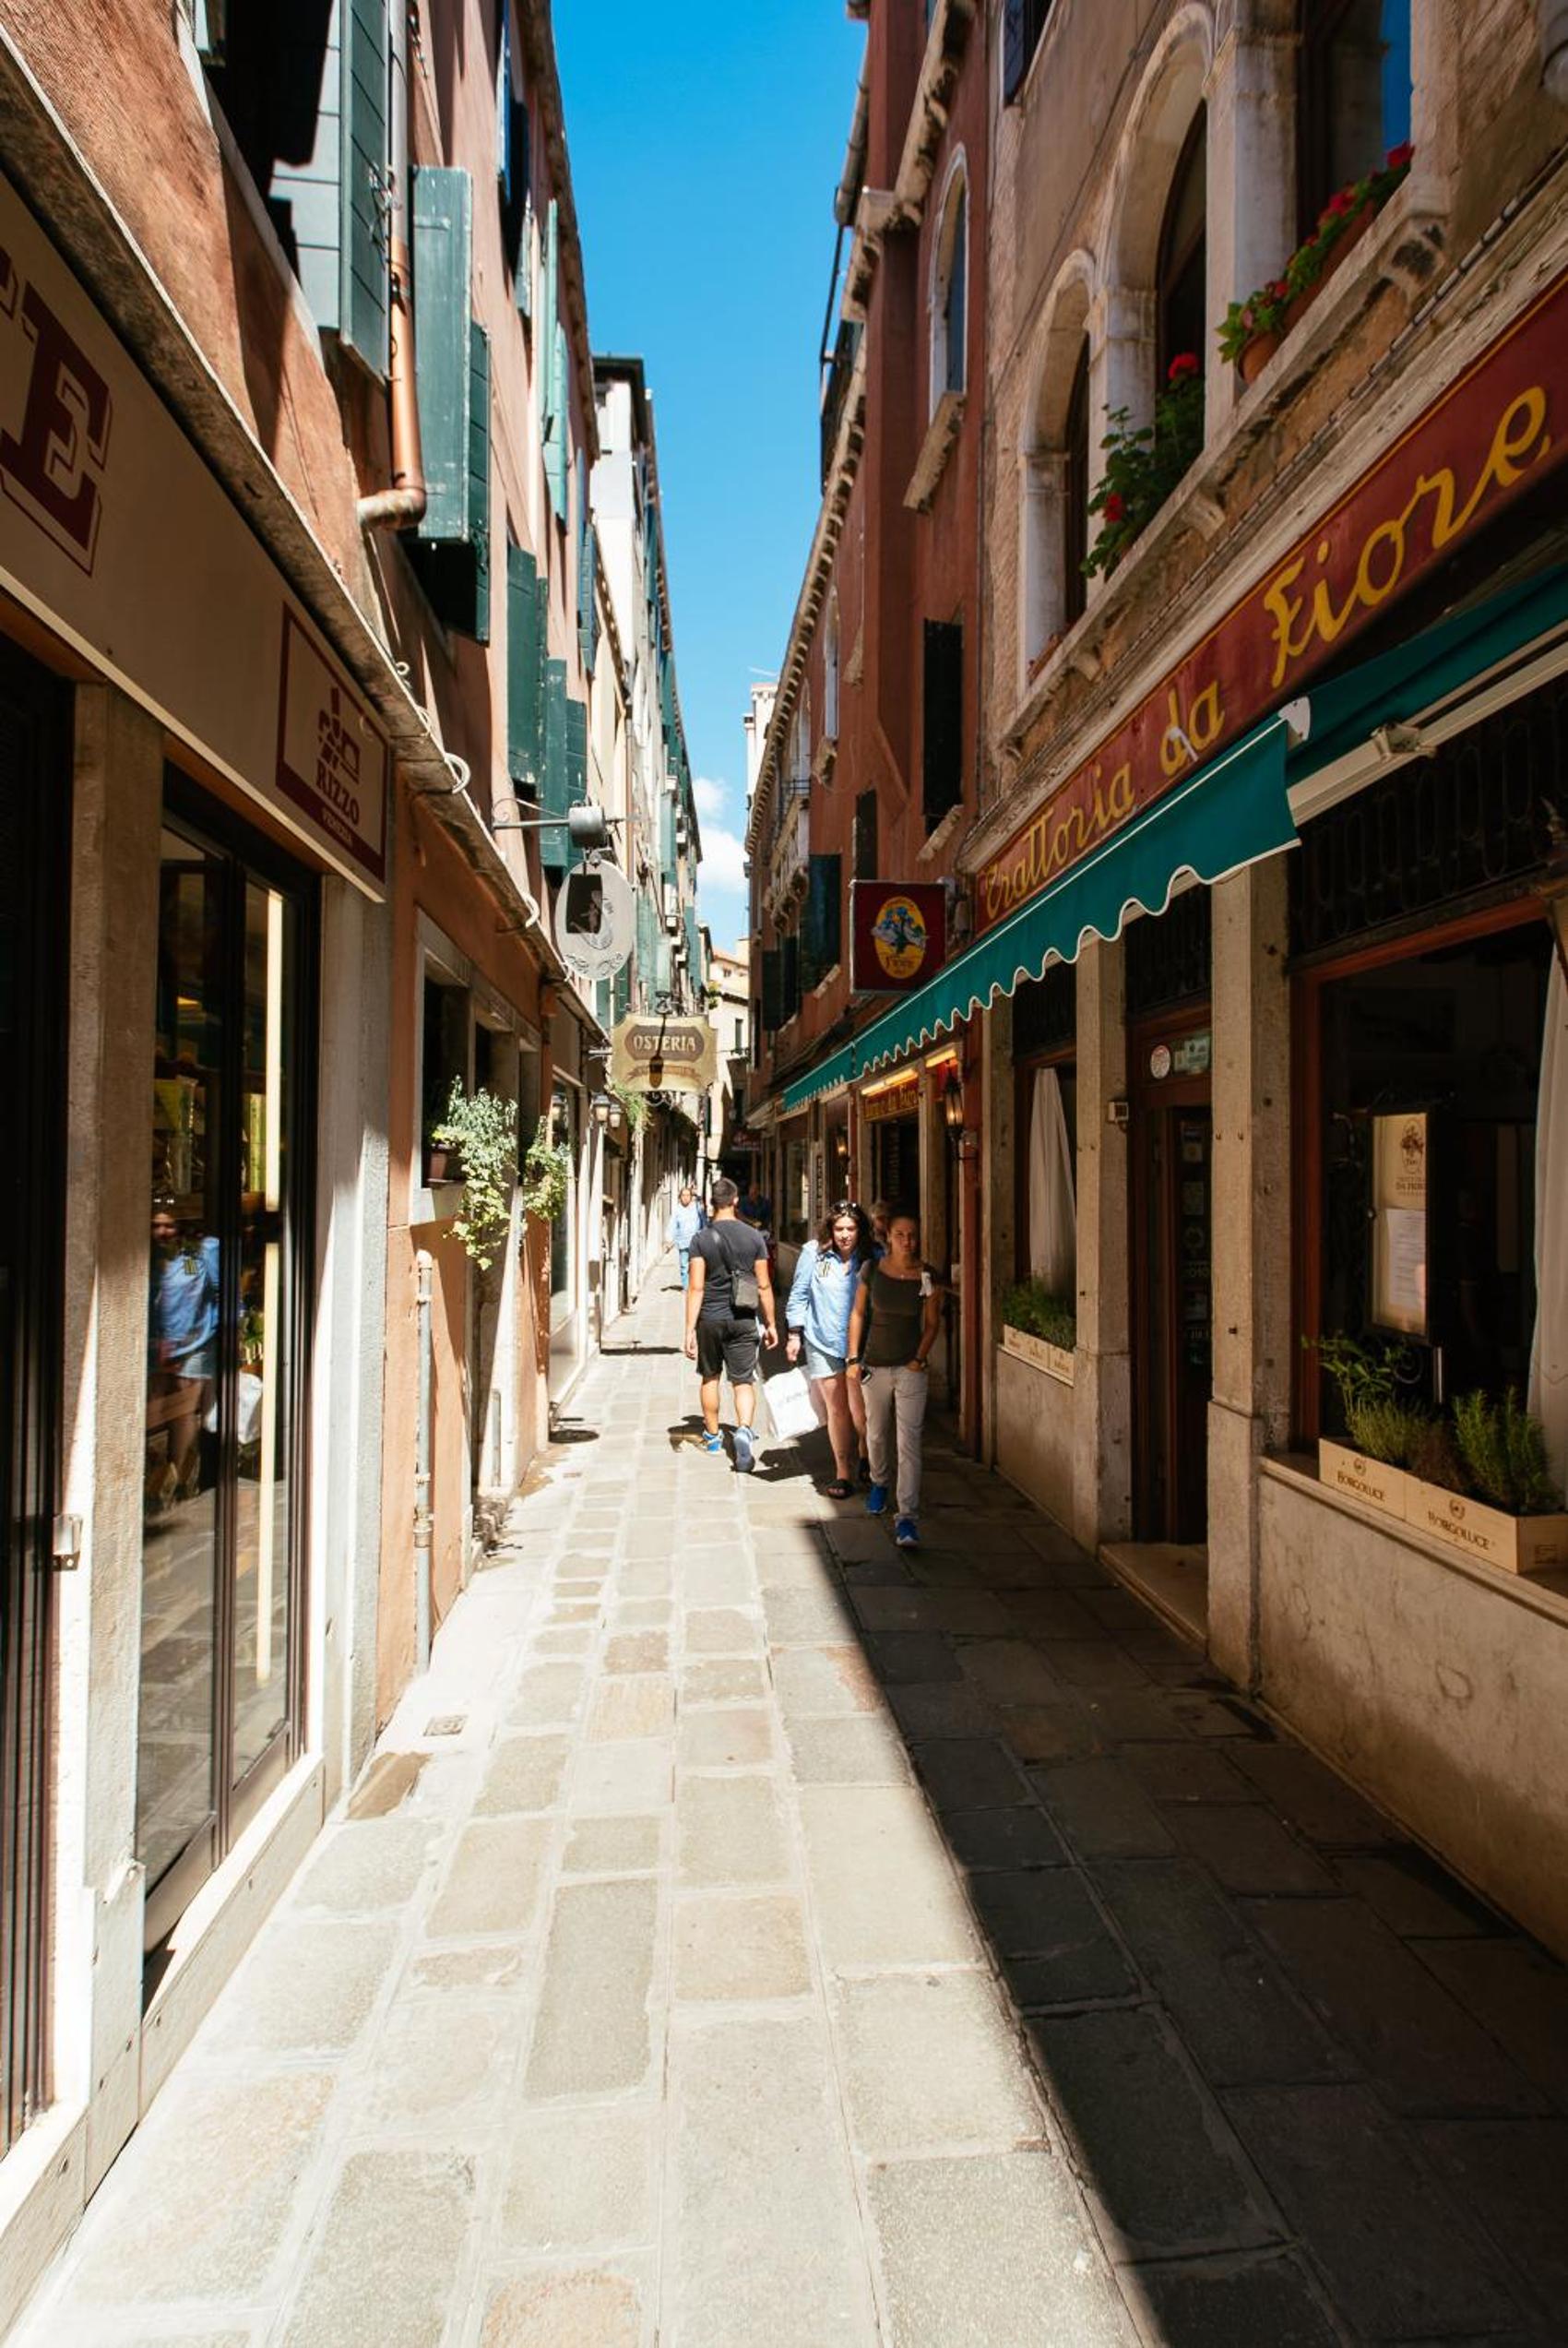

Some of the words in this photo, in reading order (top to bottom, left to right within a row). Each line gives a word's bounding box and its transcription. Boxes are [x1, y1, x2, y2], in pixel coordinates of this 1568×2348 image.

[986, 760, 1135, 919] Trattoria
[1159, 680, 1225, 777] da
[1264, 386, 1551, 688] Fiore
[316, 758, 360, 826] RIZZO
[633, 1034, 696, 1052] OSTERIA
[1336, 1470, 1385, 1502] BORGOLUCE
[1427, 1509, 1490, 1551] BORGOLUCE
